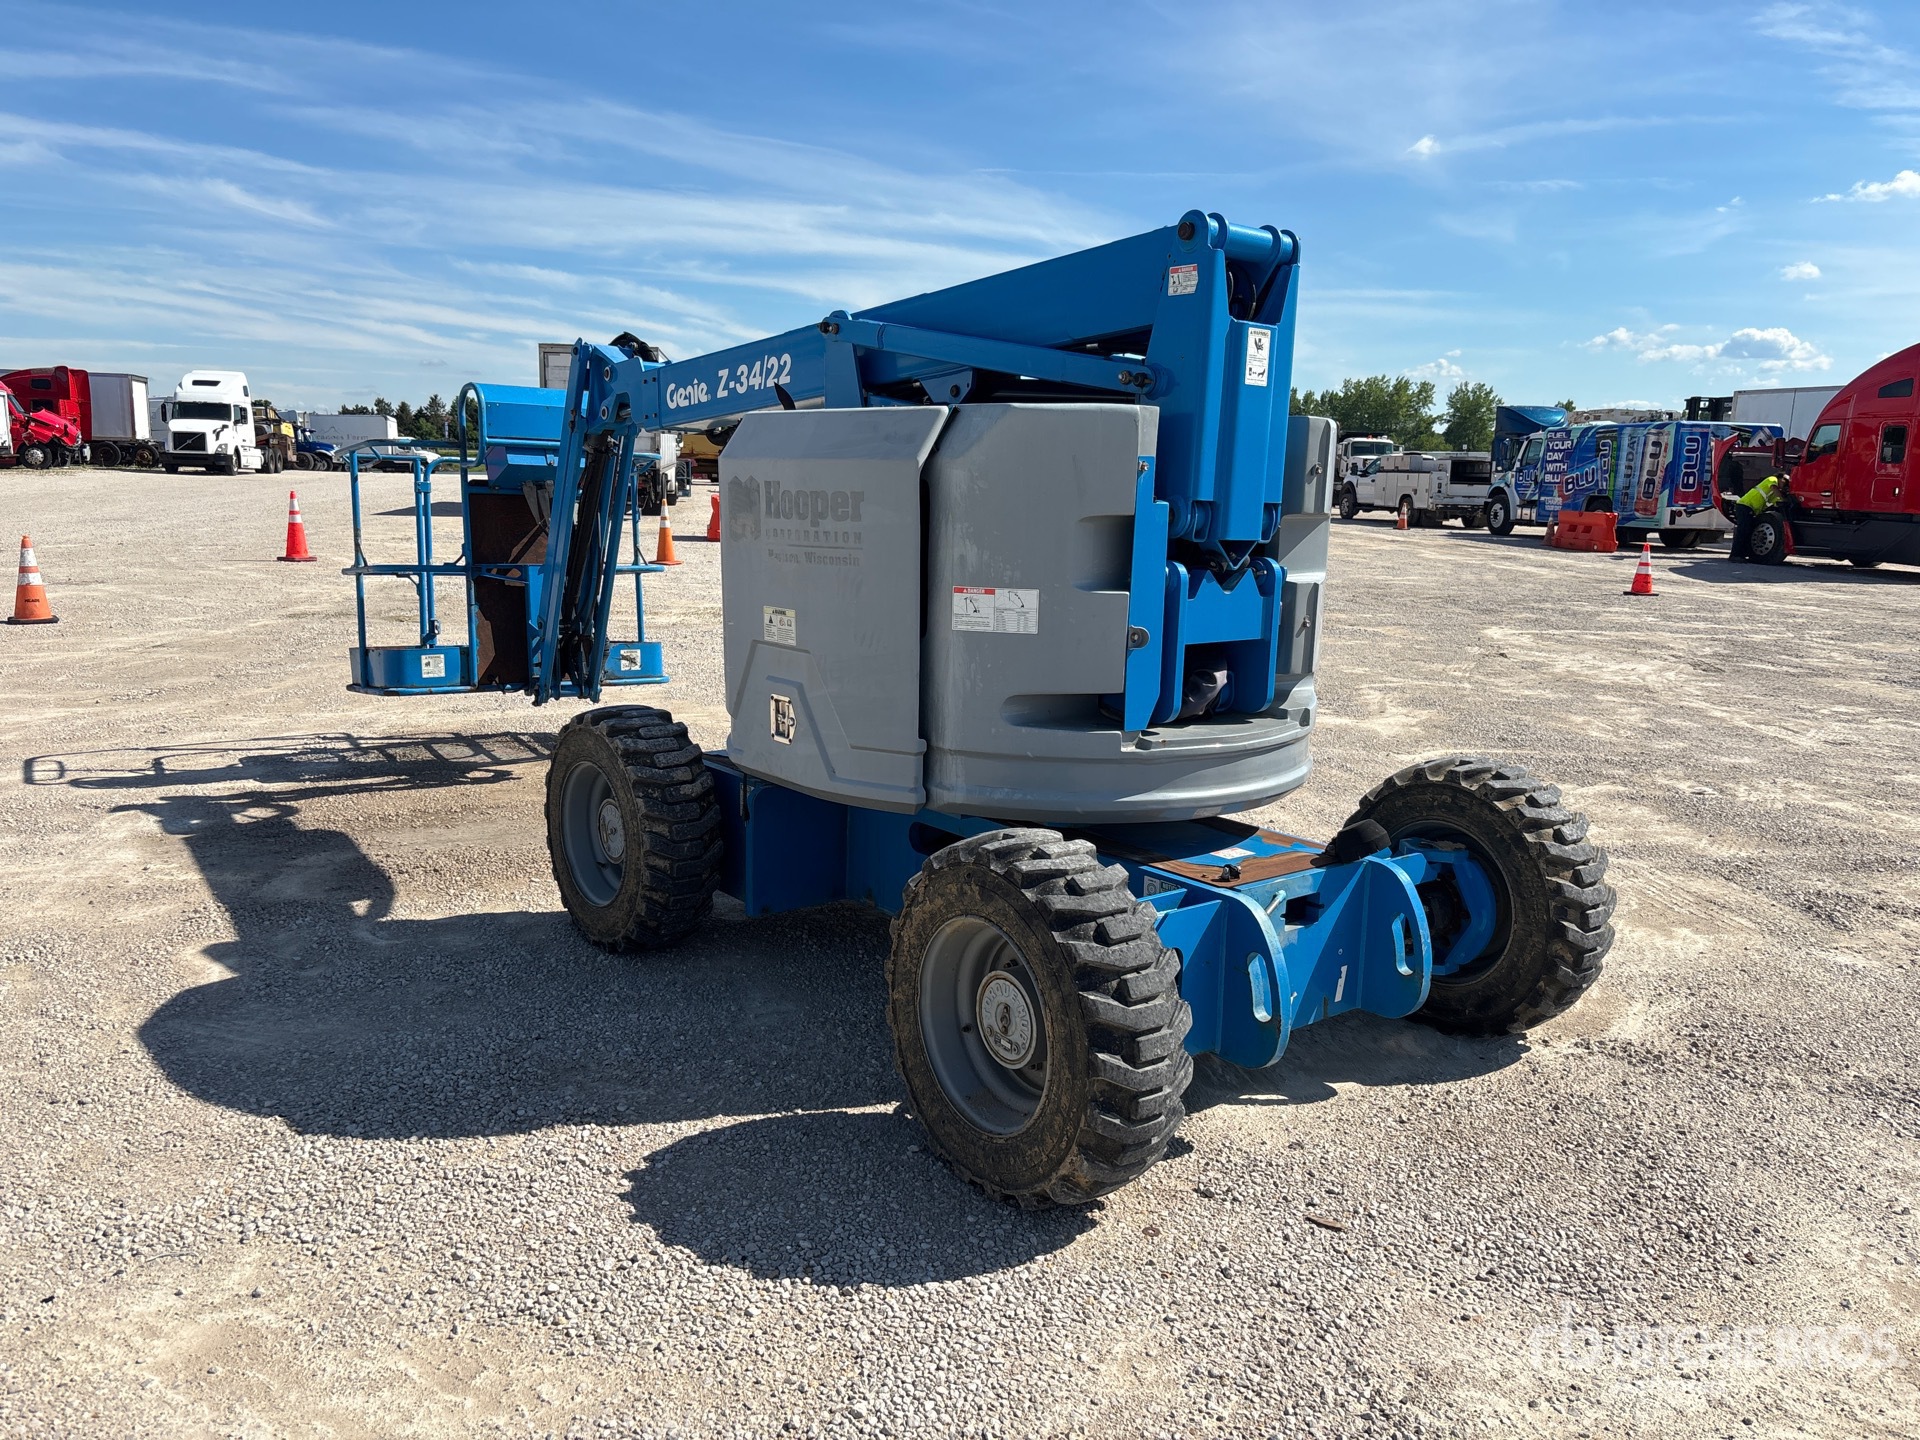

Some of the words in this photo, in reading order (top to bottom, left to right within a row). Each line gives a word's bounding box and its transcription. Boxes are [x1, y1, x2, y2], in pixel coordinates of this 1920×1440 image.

[666, 377, 709, 410] Genie
[717, 353, 792, 399] Z-34/22
[1547, 431, 1568, 439] FUEL
[1547, 441, 1572, 450] YOUR
[1546, 452, 1564, 461] DAY
[1681, 435, 1702, 491] BLU
[1546, 462, 1568, 472] WITH
[1641, 440, 1662, 500] BLU
[1544, 473, 1561, 483] BLU
[1563, 465, 1597, 495] BLU
[764, 480, 865, 527] Hooper
[803, 551, 860, 567] Wisconsin
